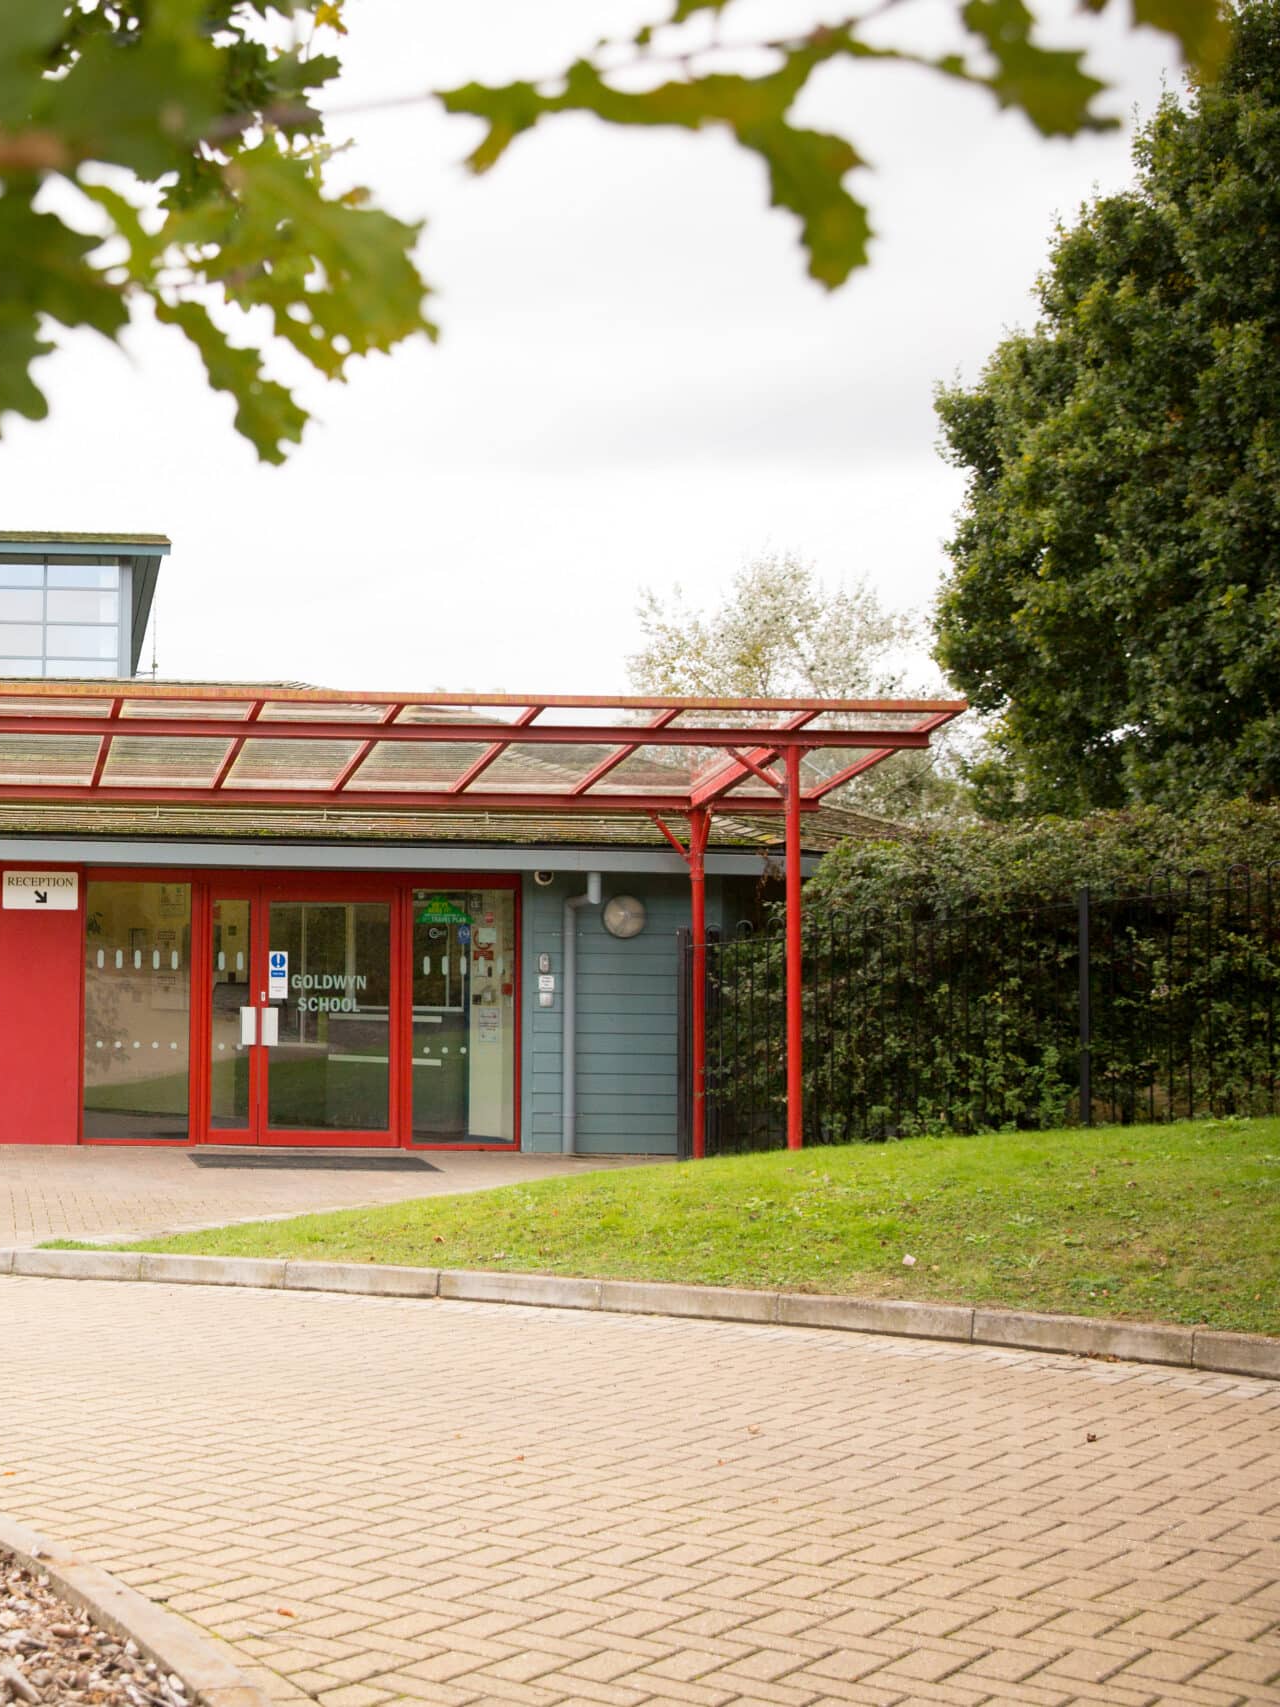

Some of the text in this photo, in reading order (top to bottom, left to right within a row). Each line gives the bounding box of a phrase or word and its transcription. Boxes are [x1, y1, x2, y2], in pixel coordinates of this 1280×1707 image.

[7, 876, 74, 887] RECEPTION
[291, 974, 367, 990] GOLDWYN
[297, 997, 361, 1012] SCHOOL
